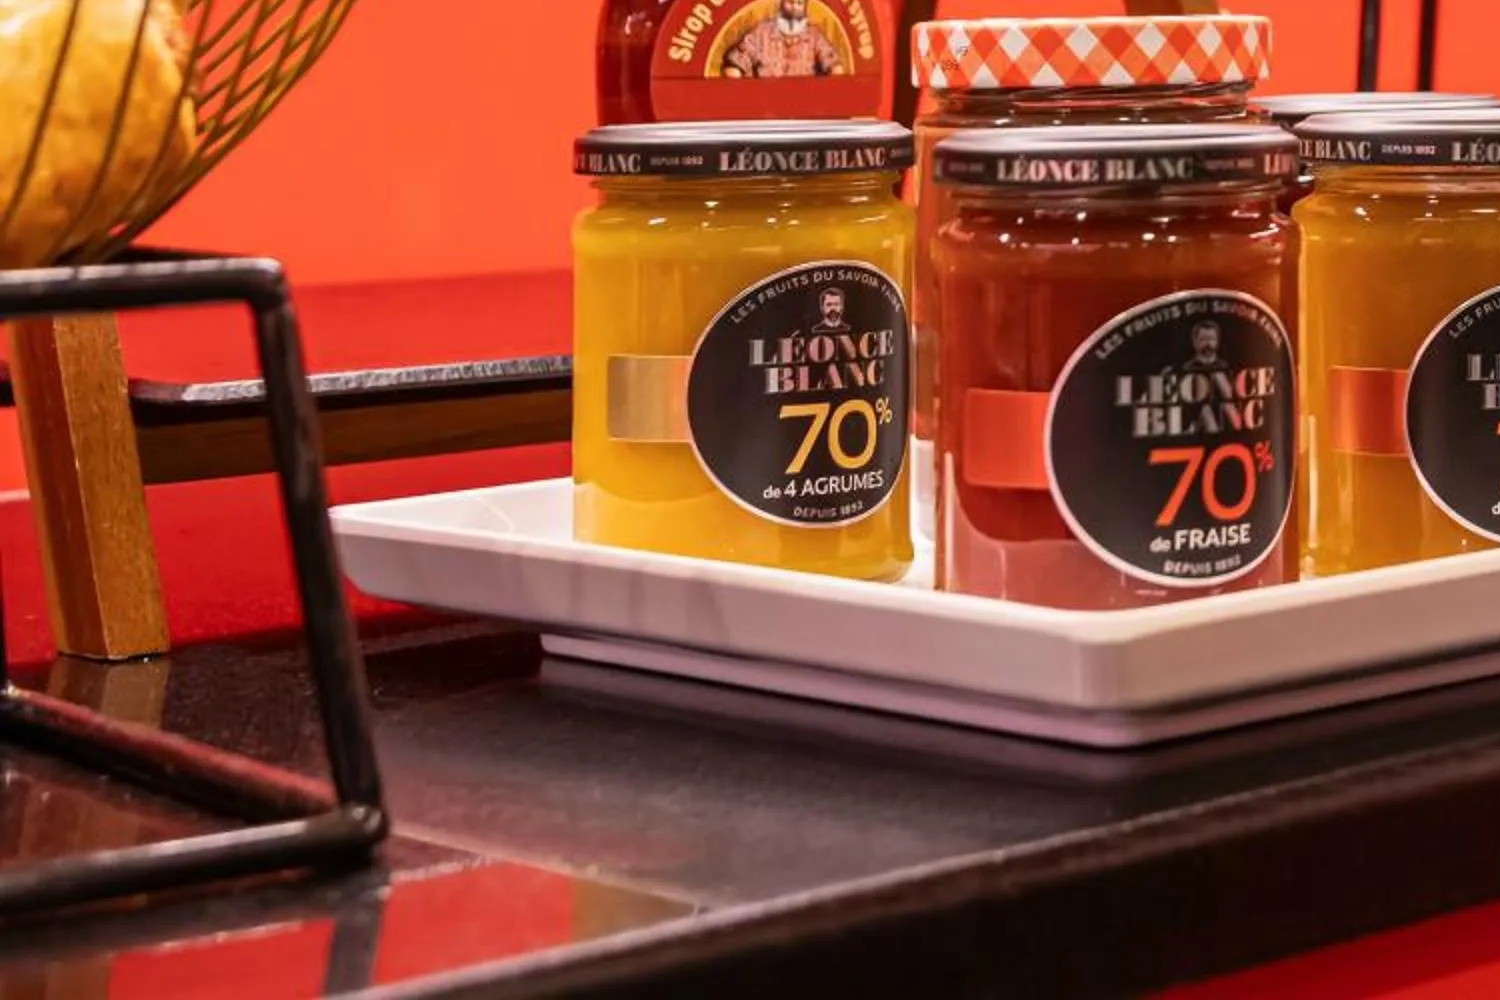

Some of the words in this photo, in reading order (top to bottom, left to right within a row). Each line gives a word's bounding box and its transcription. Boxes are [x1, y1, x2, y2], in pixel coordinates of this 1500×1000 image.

[667, 3, 713, 63] Sirop
[589, 152, 641, 174] BLANC
[719, 146, 819, 172] LÉONCE
[825, 147, 887, 169] BLANC
[1315, 138, 1371, 161] BLANC
[996, 152, 1099, 183] LÉONCE
[1105, 157, 1194, 182] BLANC
[729, 299, 756, 324] LES
[757, 274, 810, 303] FRUITS
[813, 270, 834, 282] DU
[1095, 332, 1124, 360] LES
[1124, 304, 1182, 337] FRUITS
[1449, 315, 1474, 339] LES
[749, 329, 895, 366] LÉONCE
[764, 359, 885, 394] BLANC
[1115, 366, 1276, 406] LÉONCE
[1132, 399, 1264, 437] BLANC
[763, 483, 782, 500] de
[783, 481, 798, 497] 4
[800, 469, 885, 498] AGRUMES
[792, 506, 838, 518] DEPUIS
[1150, 536, 1171, 553] de
[1174, 523, 1252, 550] FRAISE
[1163, 559, 1213, 575] DEPUIS
